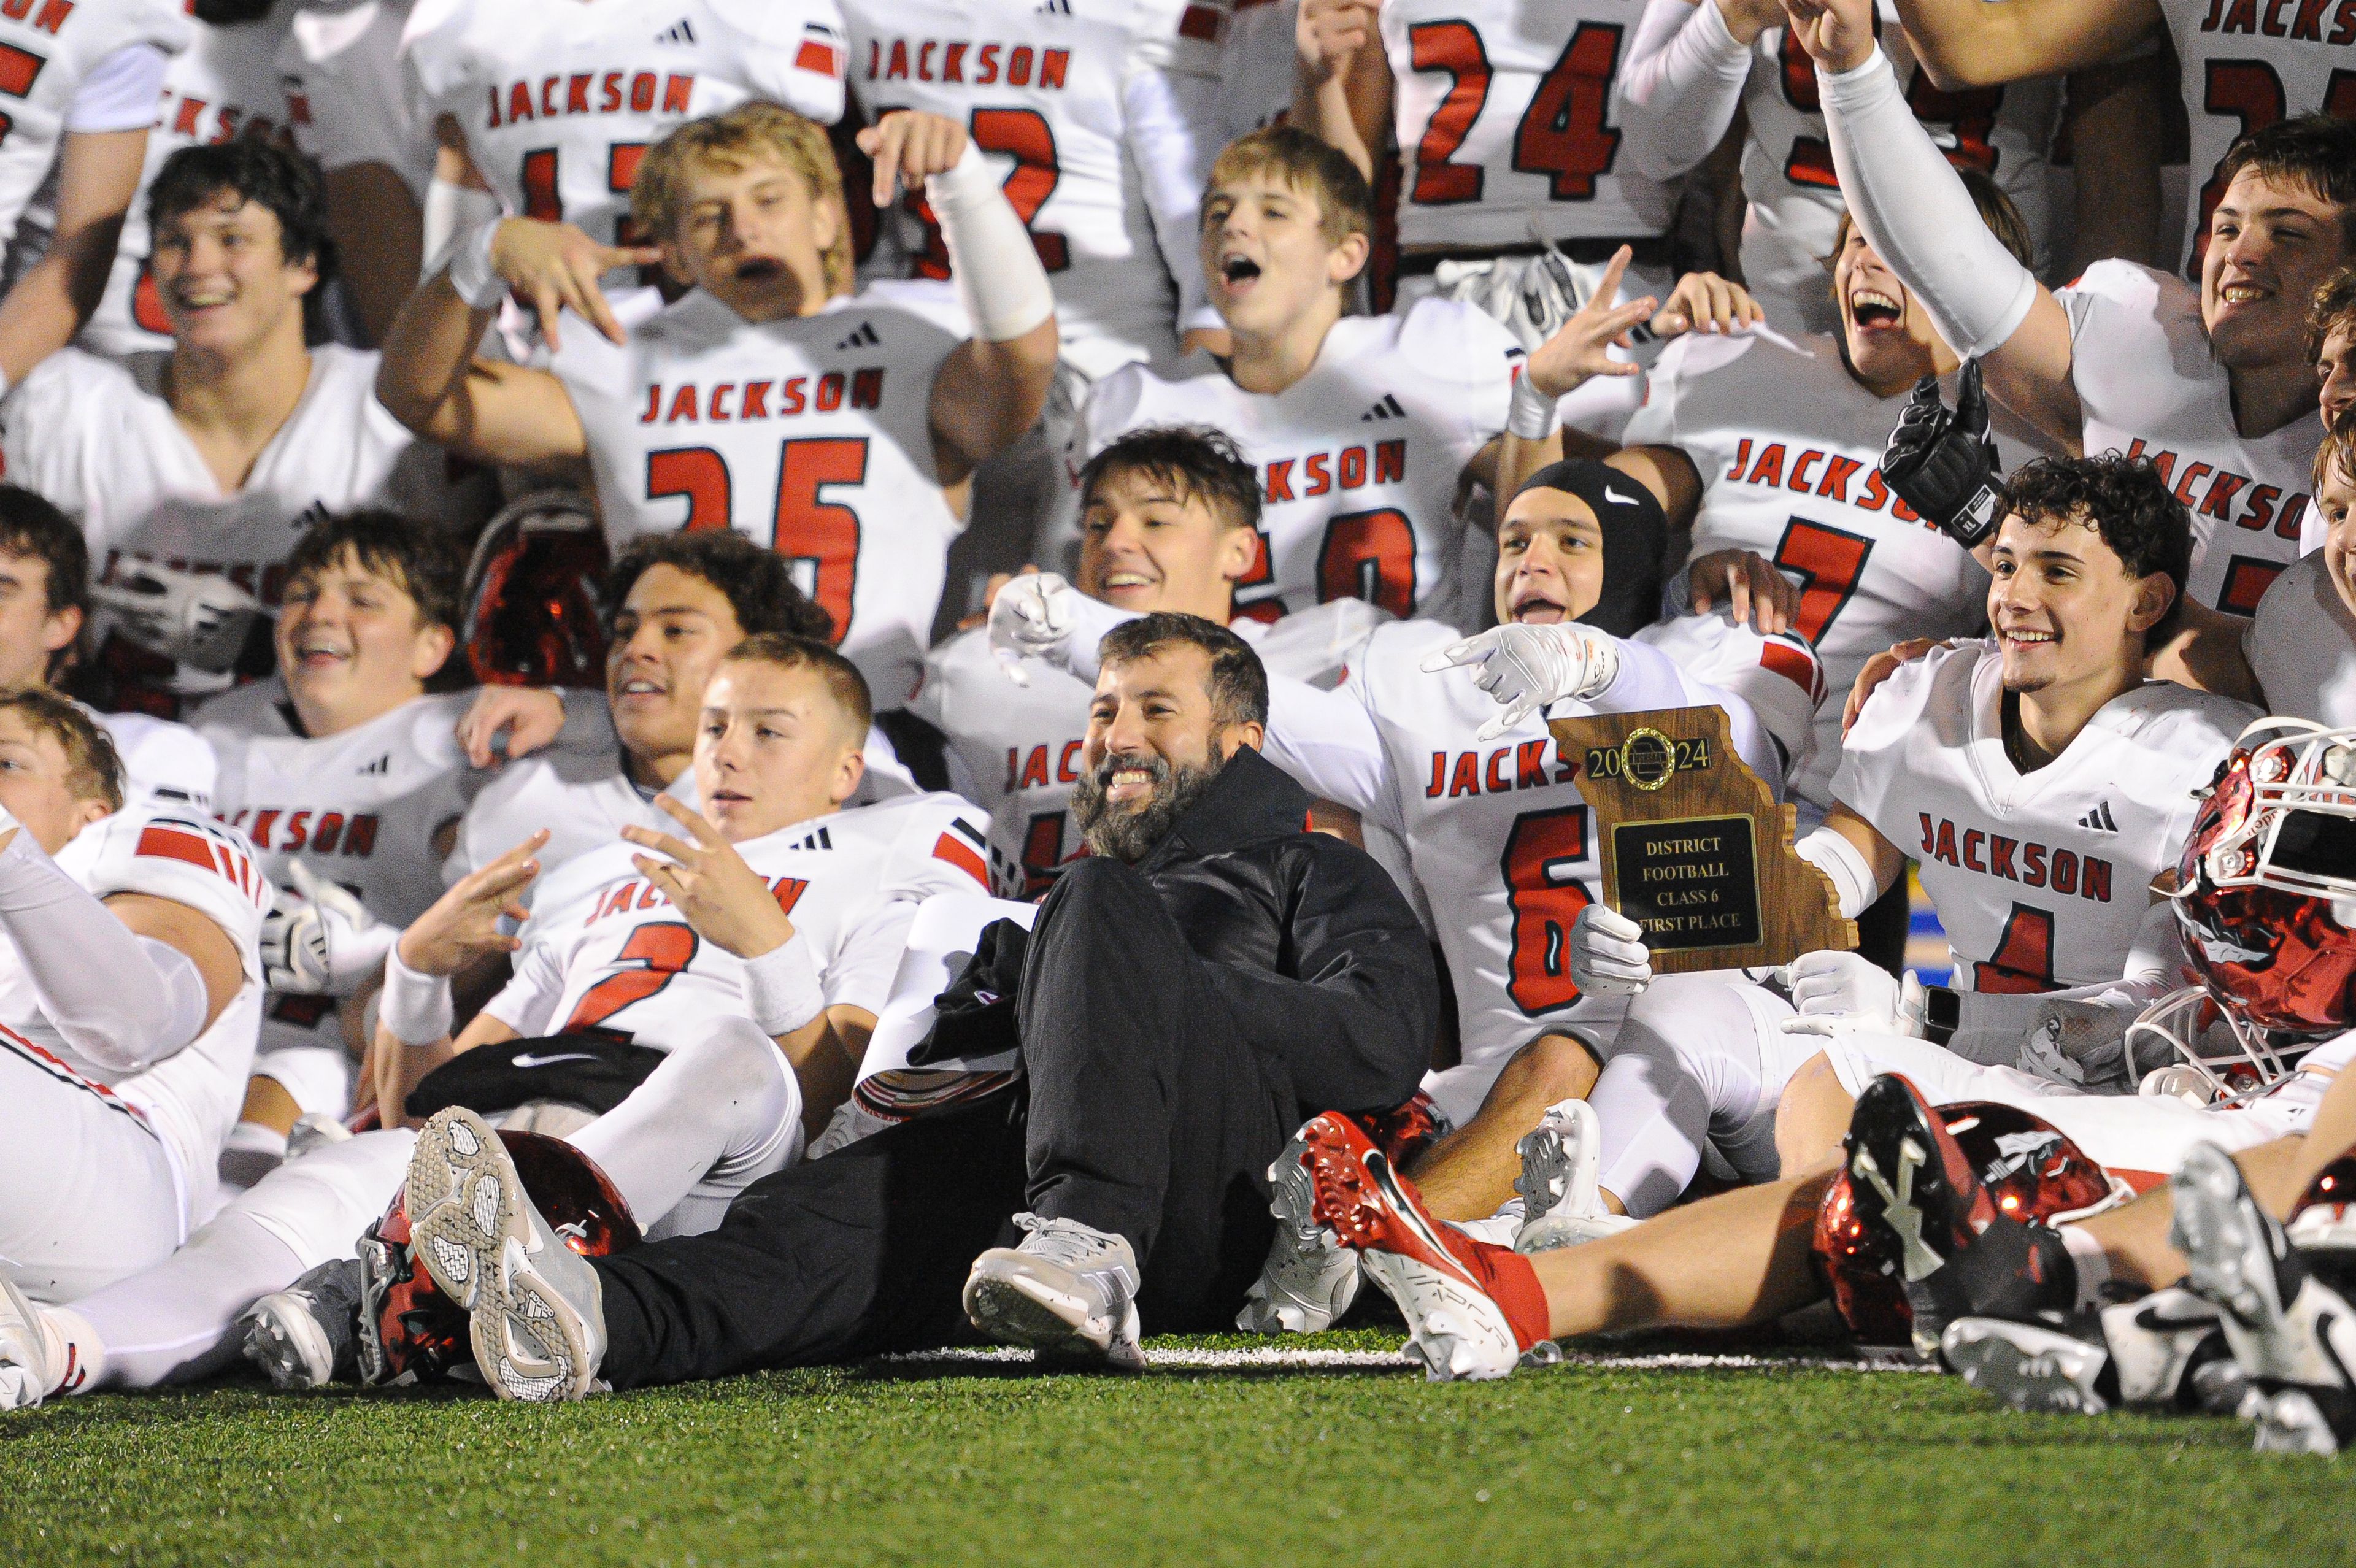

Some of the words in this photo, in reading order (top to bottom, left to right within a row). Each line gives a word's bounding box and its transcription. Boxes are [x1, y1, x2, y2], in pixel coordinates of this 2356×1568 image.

[868, 38, 1071, 90] JACKSON
[488, 71, 695, 129] JACKSON
[1408, 18, 1625, 204] 24
[639, 367, 885, 425] JACKSON
[1265, 438, 1406, 505] KSON
[1725, 437, 1939, 532] JACKS
[1589, 748, 1620, 778] 20
[1677, 739, 1708, 769] 24
[214, 809, 379, 859] KSON
[1646, 837, 1721, 856] DISTRICT
[1918, 811, 2113, 904] JACKSON
[1642, 863, 1729, 882] FOOTBALL
[1657, 890, 1707, 906] CLASS
[1711, 889, 1719, 903] 6
[1501, 804, 1595, 1018] 6
[1639, 917, 1684, 933] FIRST
[1688, 913, 1741, 930] PLACE
[1973, 901, 2073, 994] 4
[561, 921, 700, 1044] 2
[529, 1290, 555, 1318] adidas
